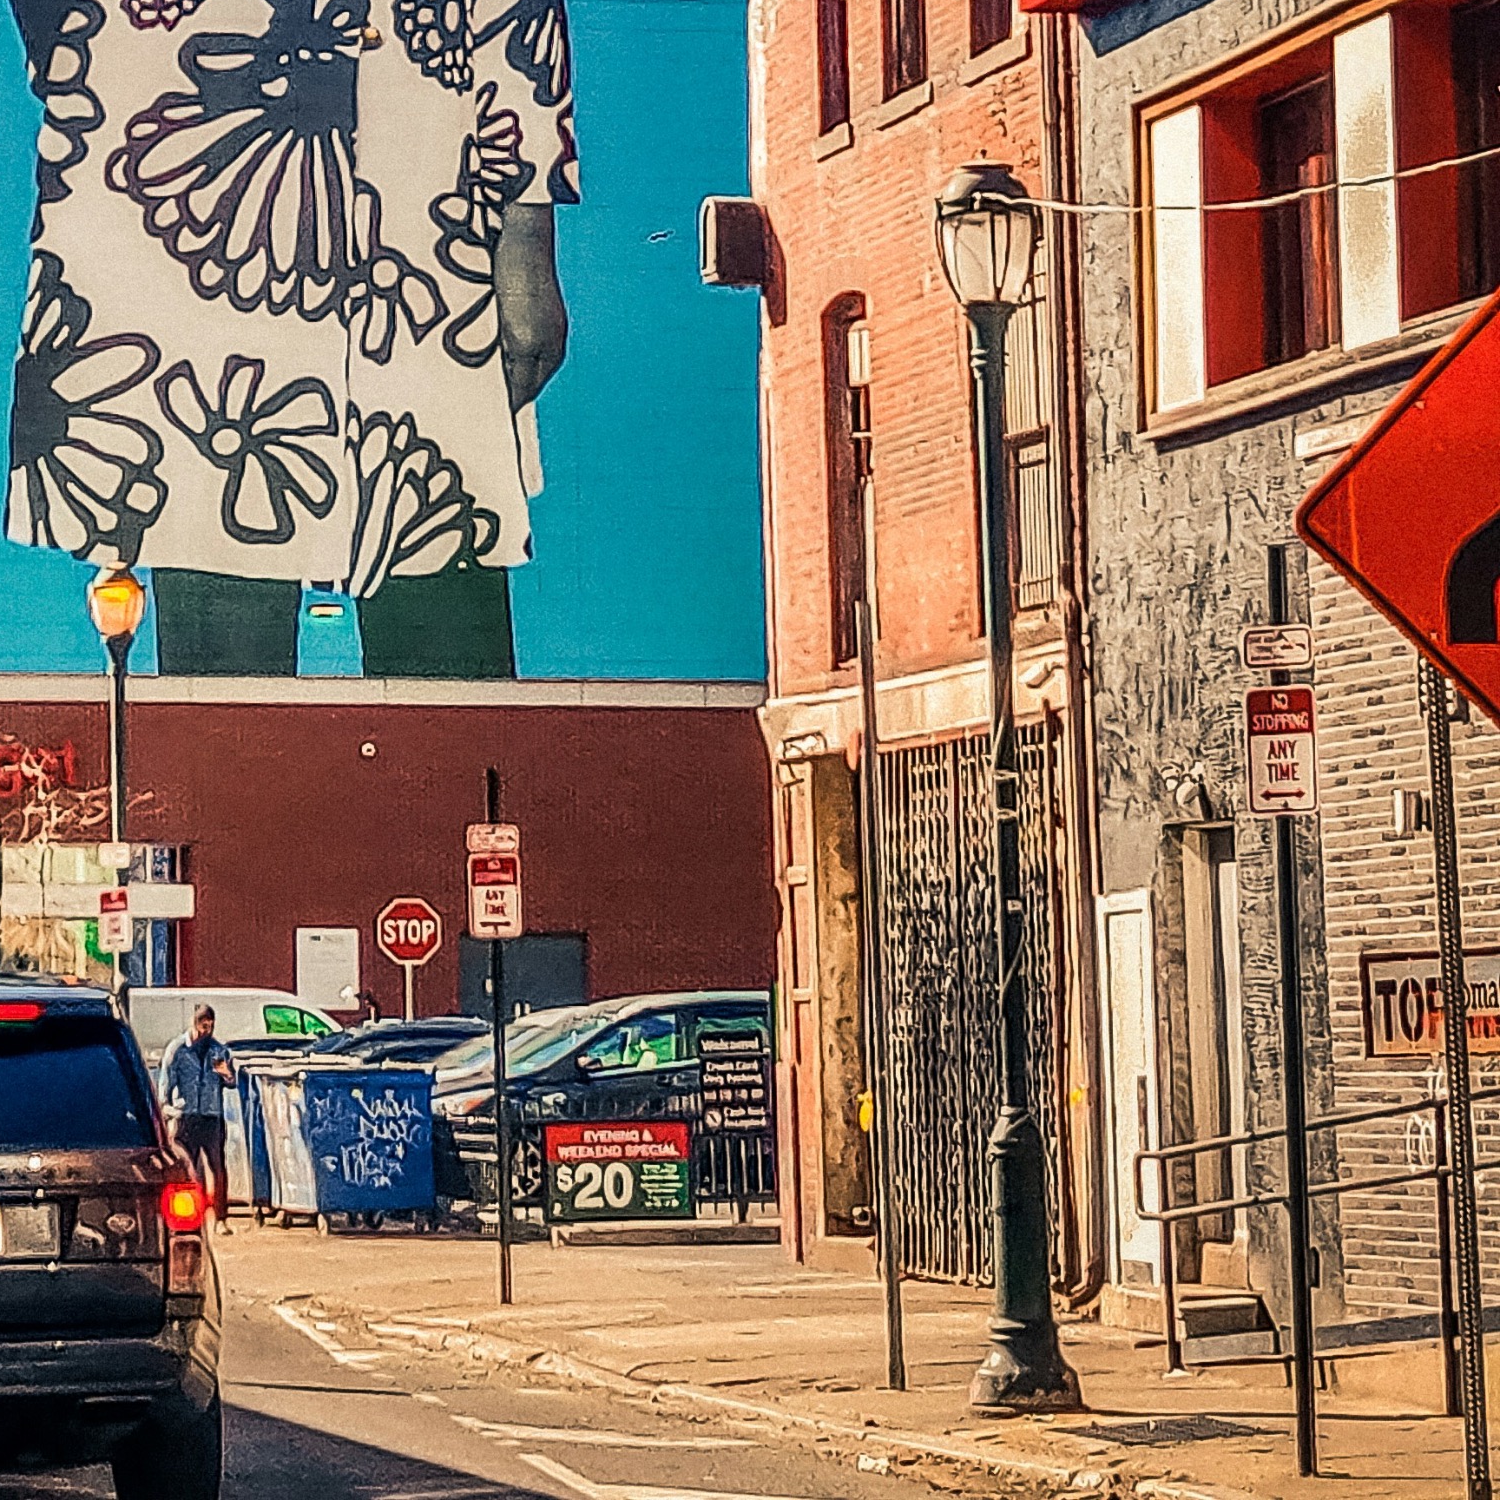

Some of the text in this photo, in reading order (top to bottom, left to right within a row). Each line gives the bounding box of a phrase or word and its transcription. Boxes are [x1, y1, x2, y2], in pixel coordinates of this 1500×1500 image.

[1271, 693, 1289, 710] NO
[1252, 713, 1309, 731] STOPPING
[1267, 740, 1297, 760] ANY
[1266, 762, 1300, 783] TIME
[383, 918, 435, 945] STOP
[556, 1162, 634, 1209] $20
